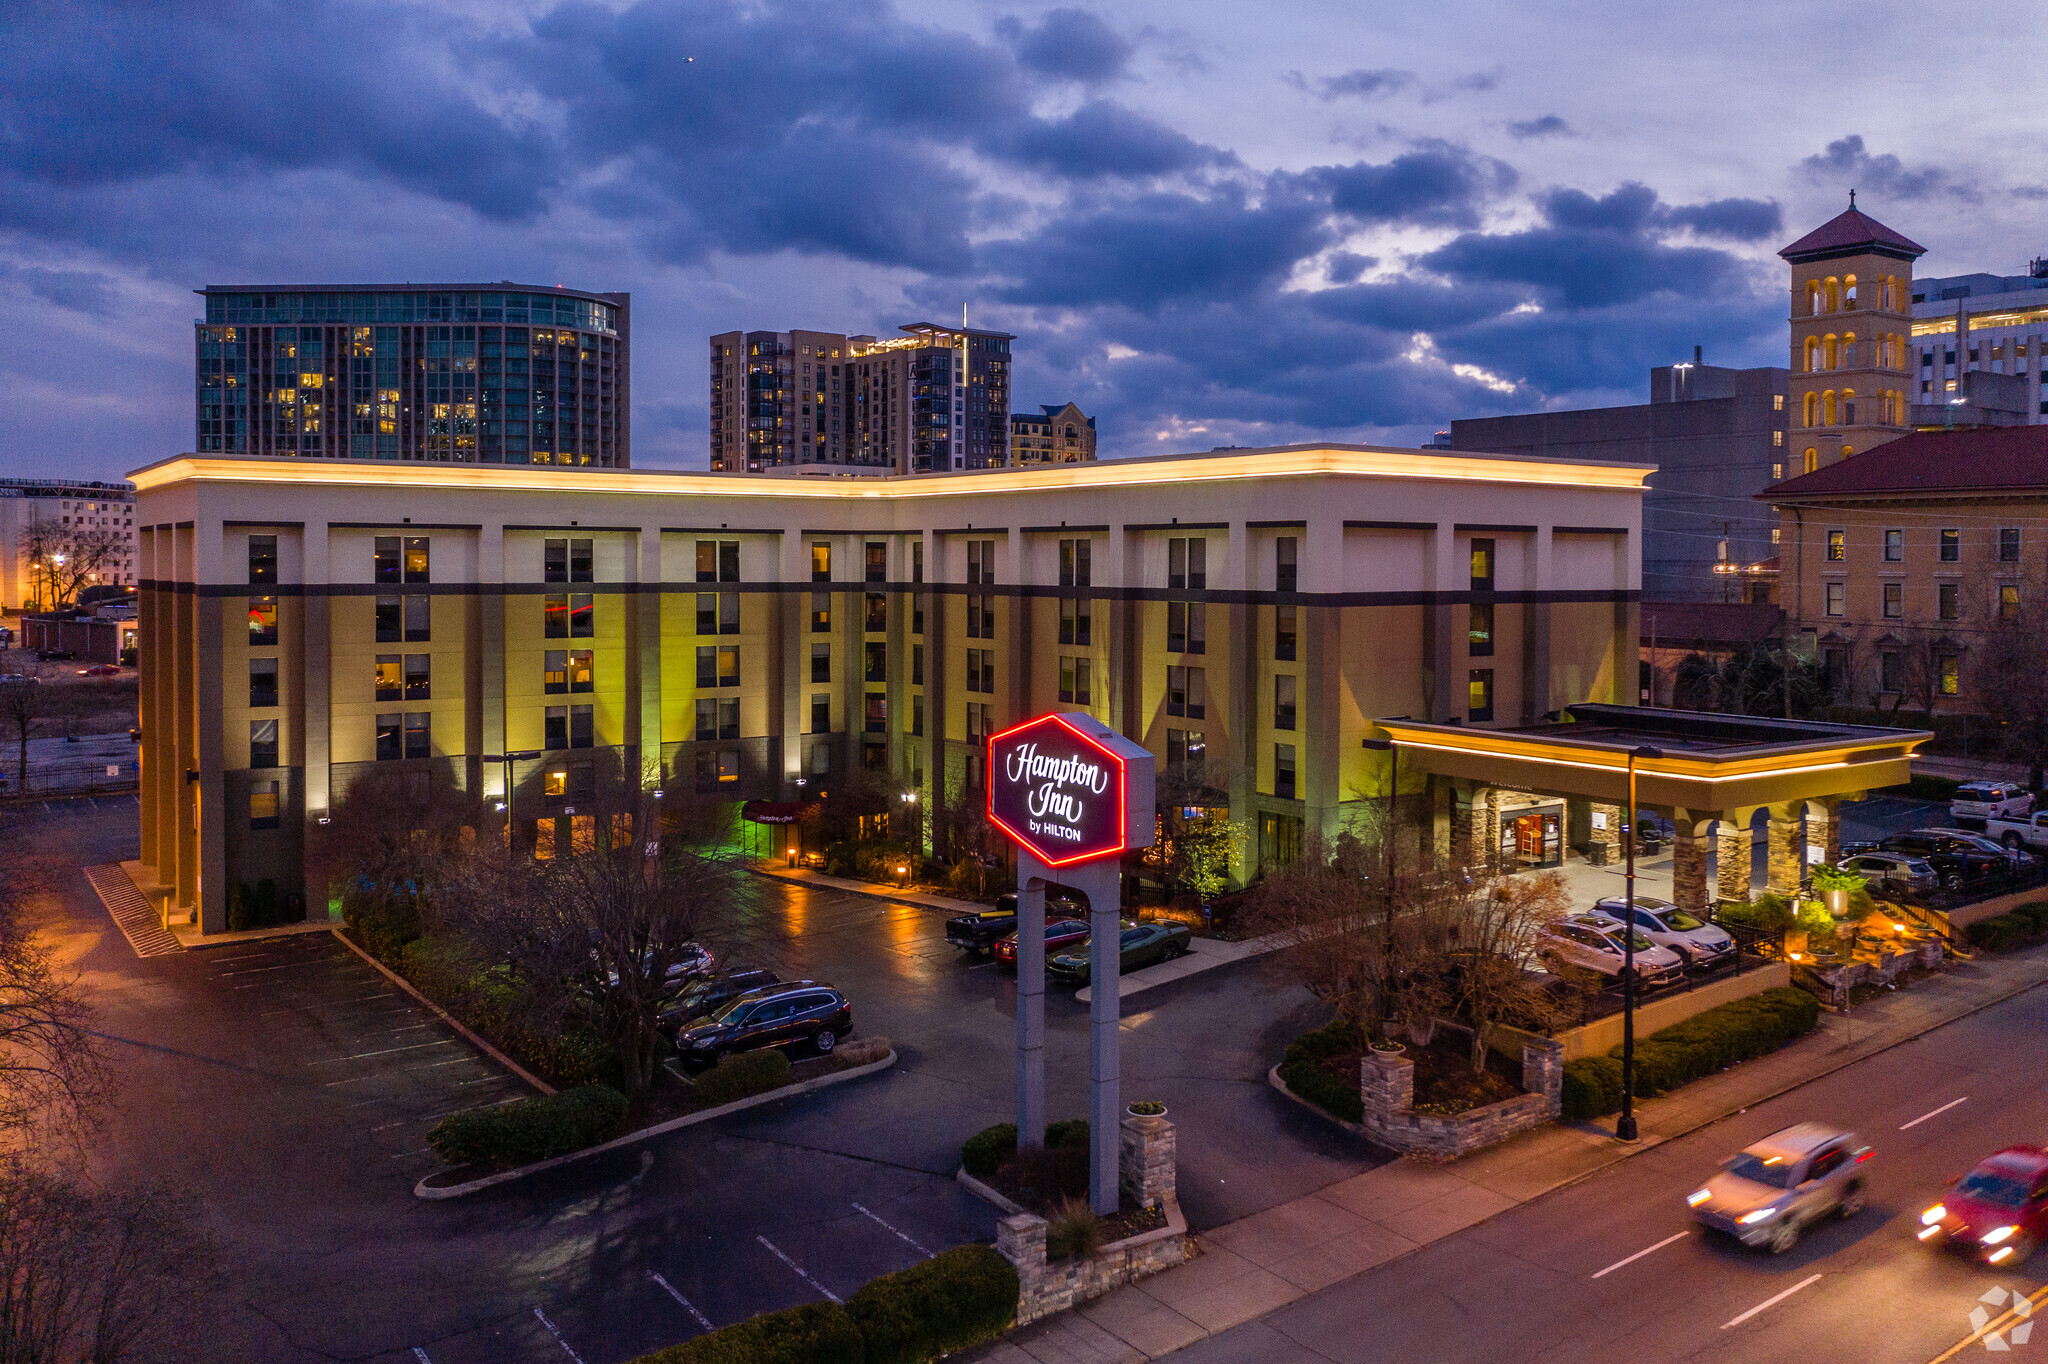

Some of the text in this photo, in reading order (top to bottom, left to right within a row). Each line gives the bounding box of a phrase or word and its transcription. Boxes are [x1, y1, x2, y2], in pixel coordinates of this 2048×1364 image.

[1006, 743, 1108, 794] Hampton
[1028, 782, 1083, 823] Inn
[1029, 819, 1081, 842] by HILTON
